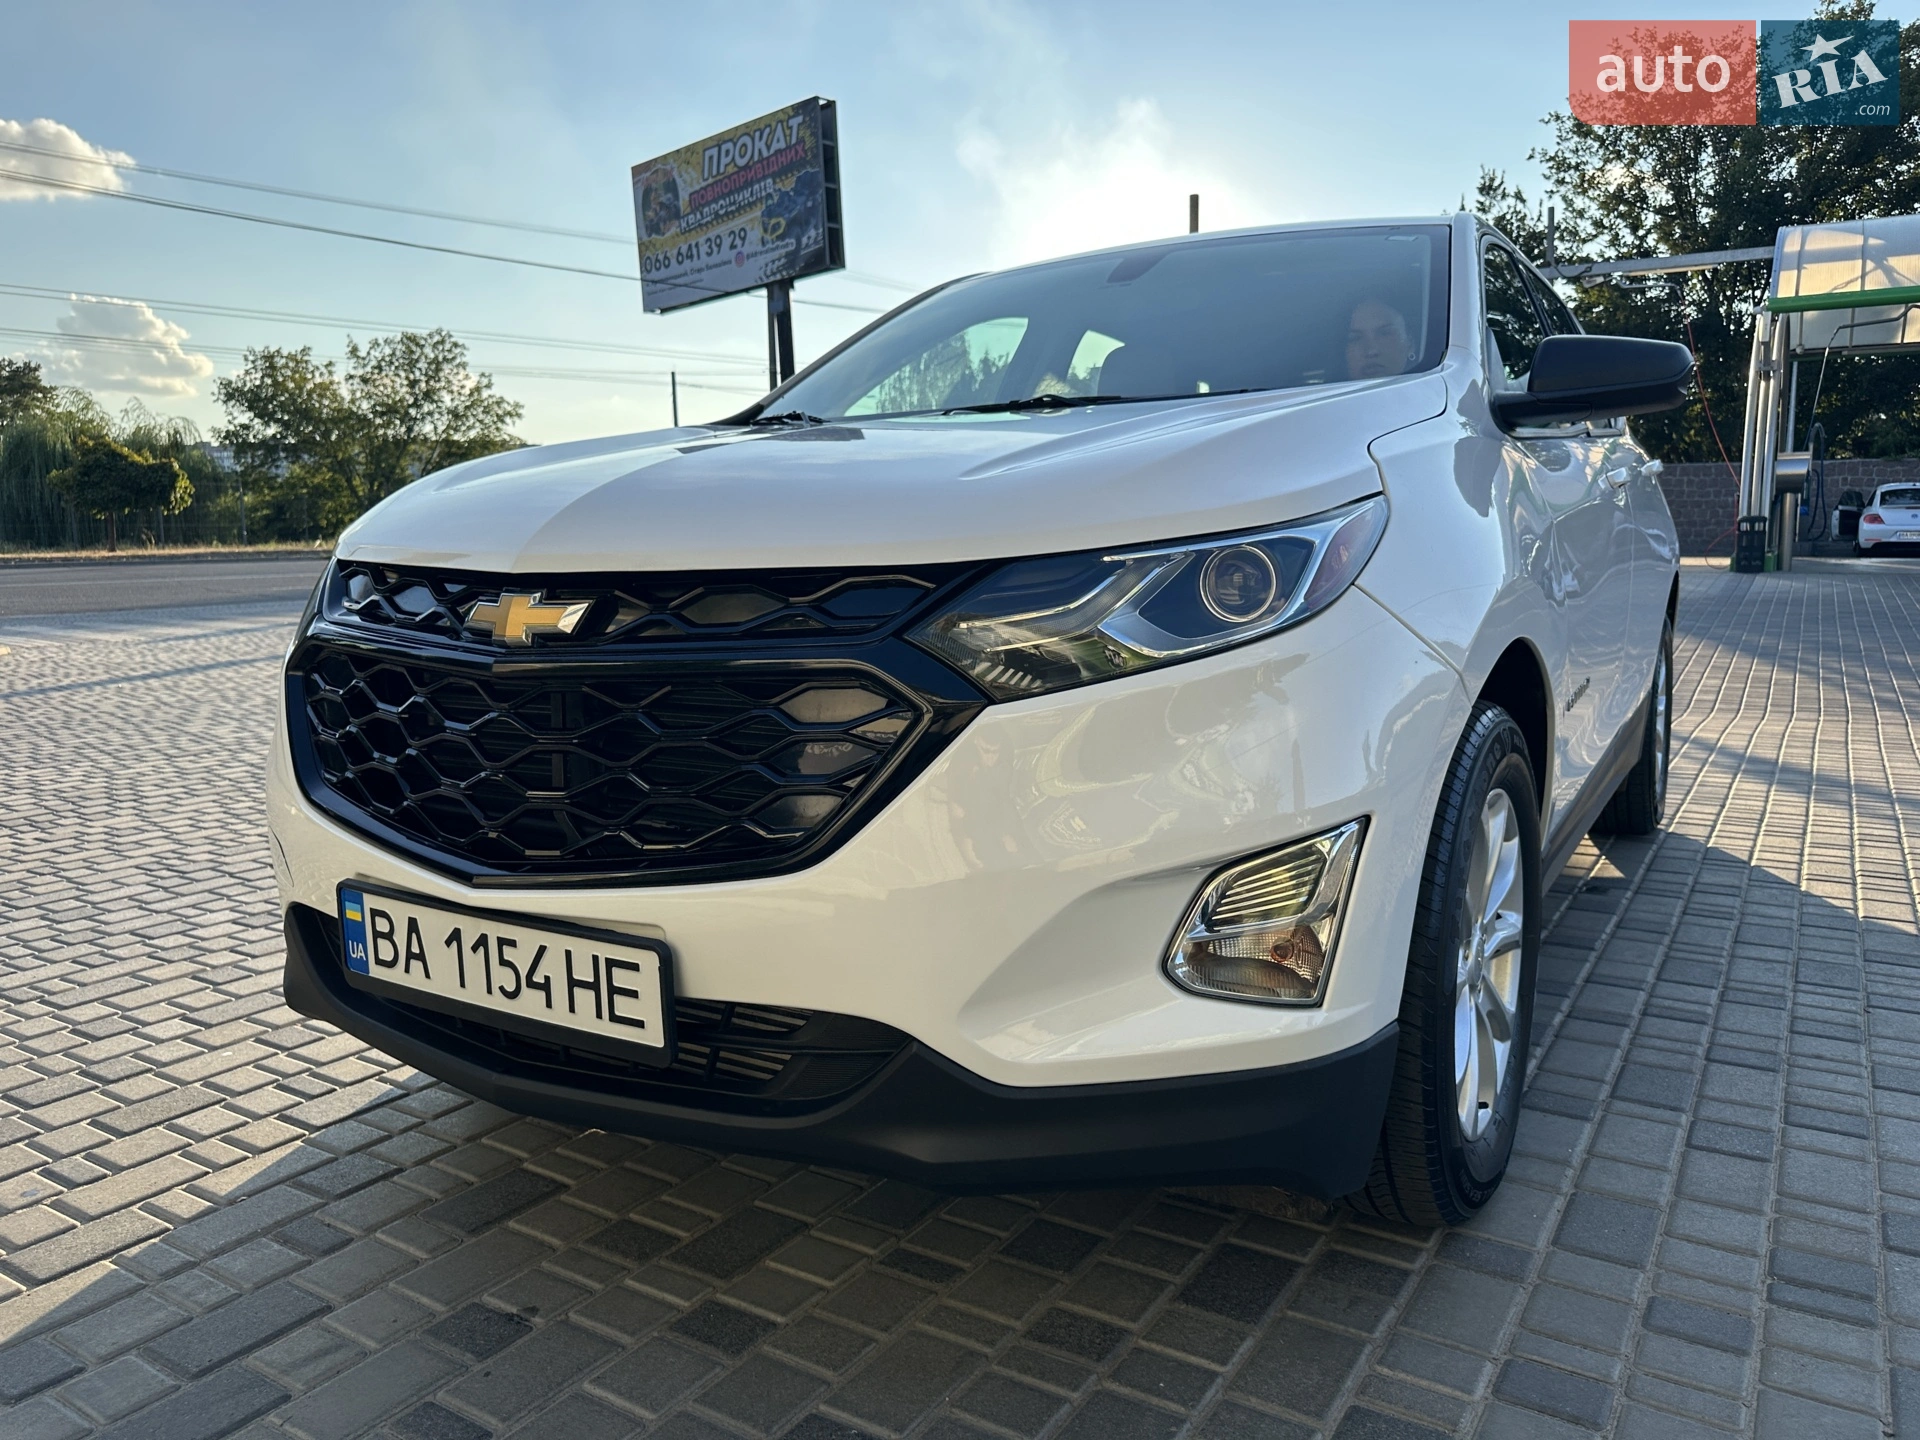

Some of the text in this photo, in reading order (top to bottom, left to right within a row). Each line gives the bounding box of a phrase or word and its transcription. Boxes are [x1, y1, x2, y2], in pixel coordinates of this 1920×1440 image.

[690, 143, 806, 208] ПОВНОПРИВІДНИХ
[702, 115, 804, 181] ПРОКАТ
[681, 179, 774, 233] КВАДРОЦИКЛІВ
[644, 249, 671, 274] 066
[676, 243, 700, 265] 641
[705, 234, 722, 258] 39
[728, 227, 747, 250] 29
[349, 939, 367, 961] UA
[369, 907, 646, 1029] BA 1154 HE
